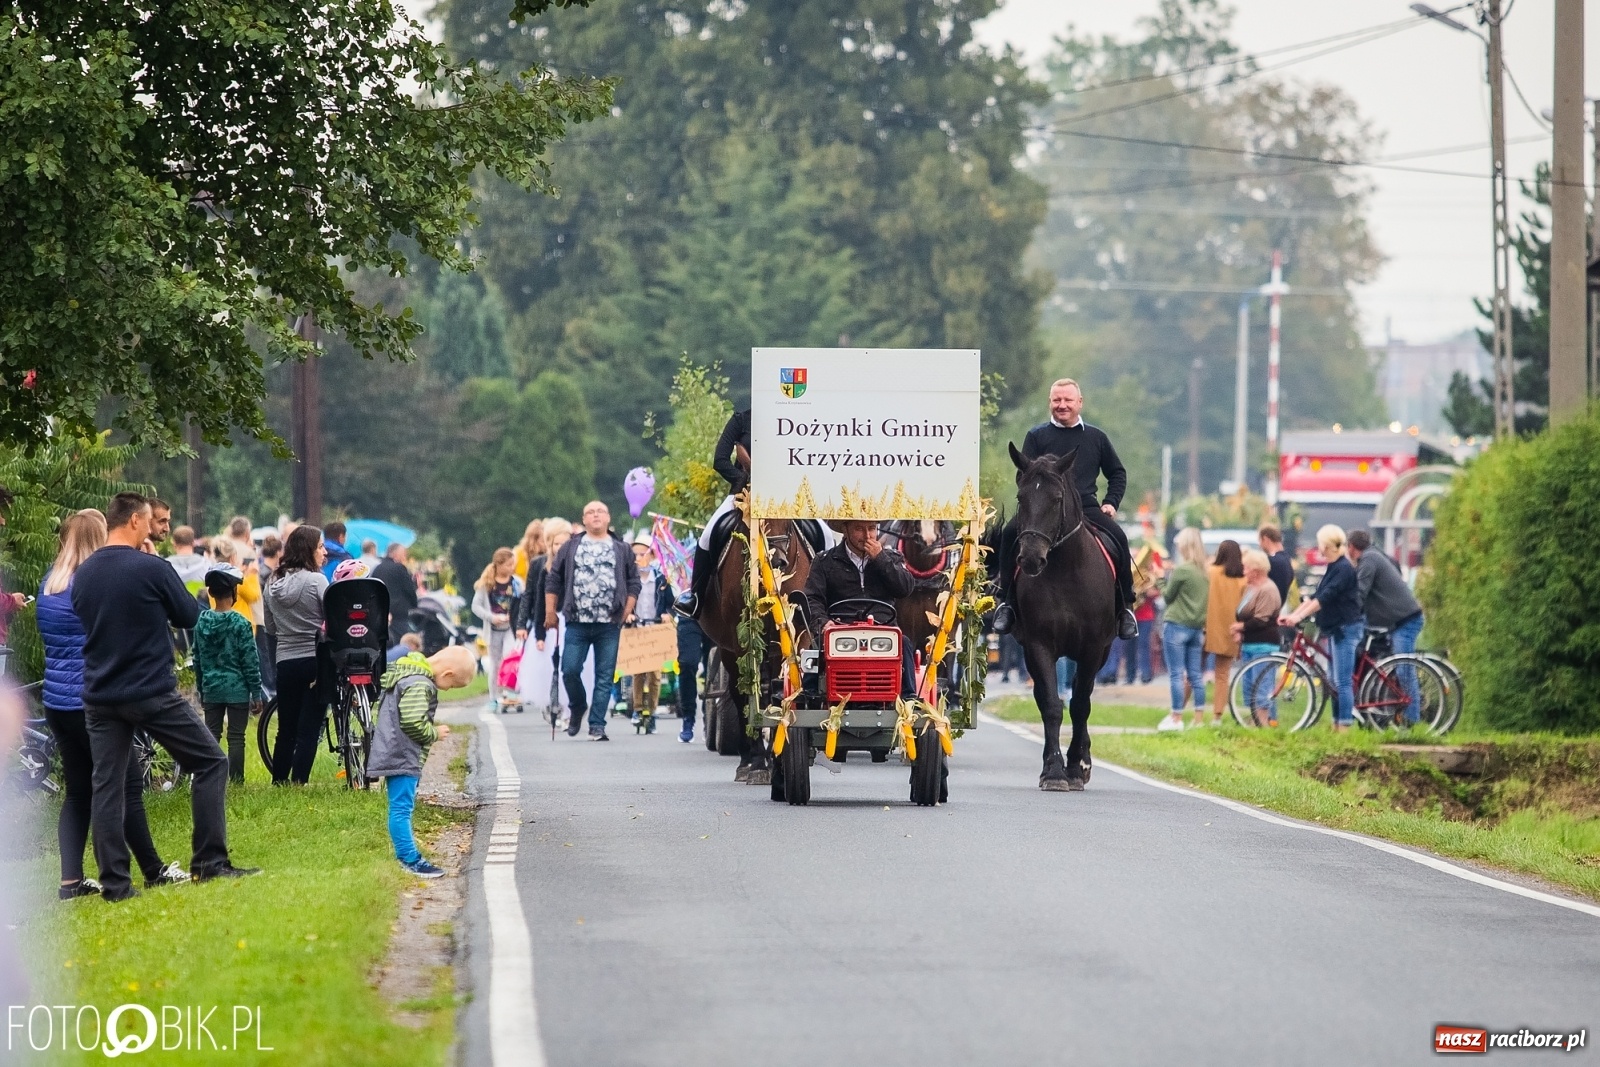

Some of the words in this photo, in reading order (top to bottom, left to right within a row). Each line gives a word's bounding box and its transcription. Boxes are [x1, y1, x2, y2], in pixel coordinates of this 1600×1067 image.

[776, 417, 873, 442] Dożynki
[881, 418, 958, 443] Gminy
[787, 447, 946, 472] Krzyżanowice
